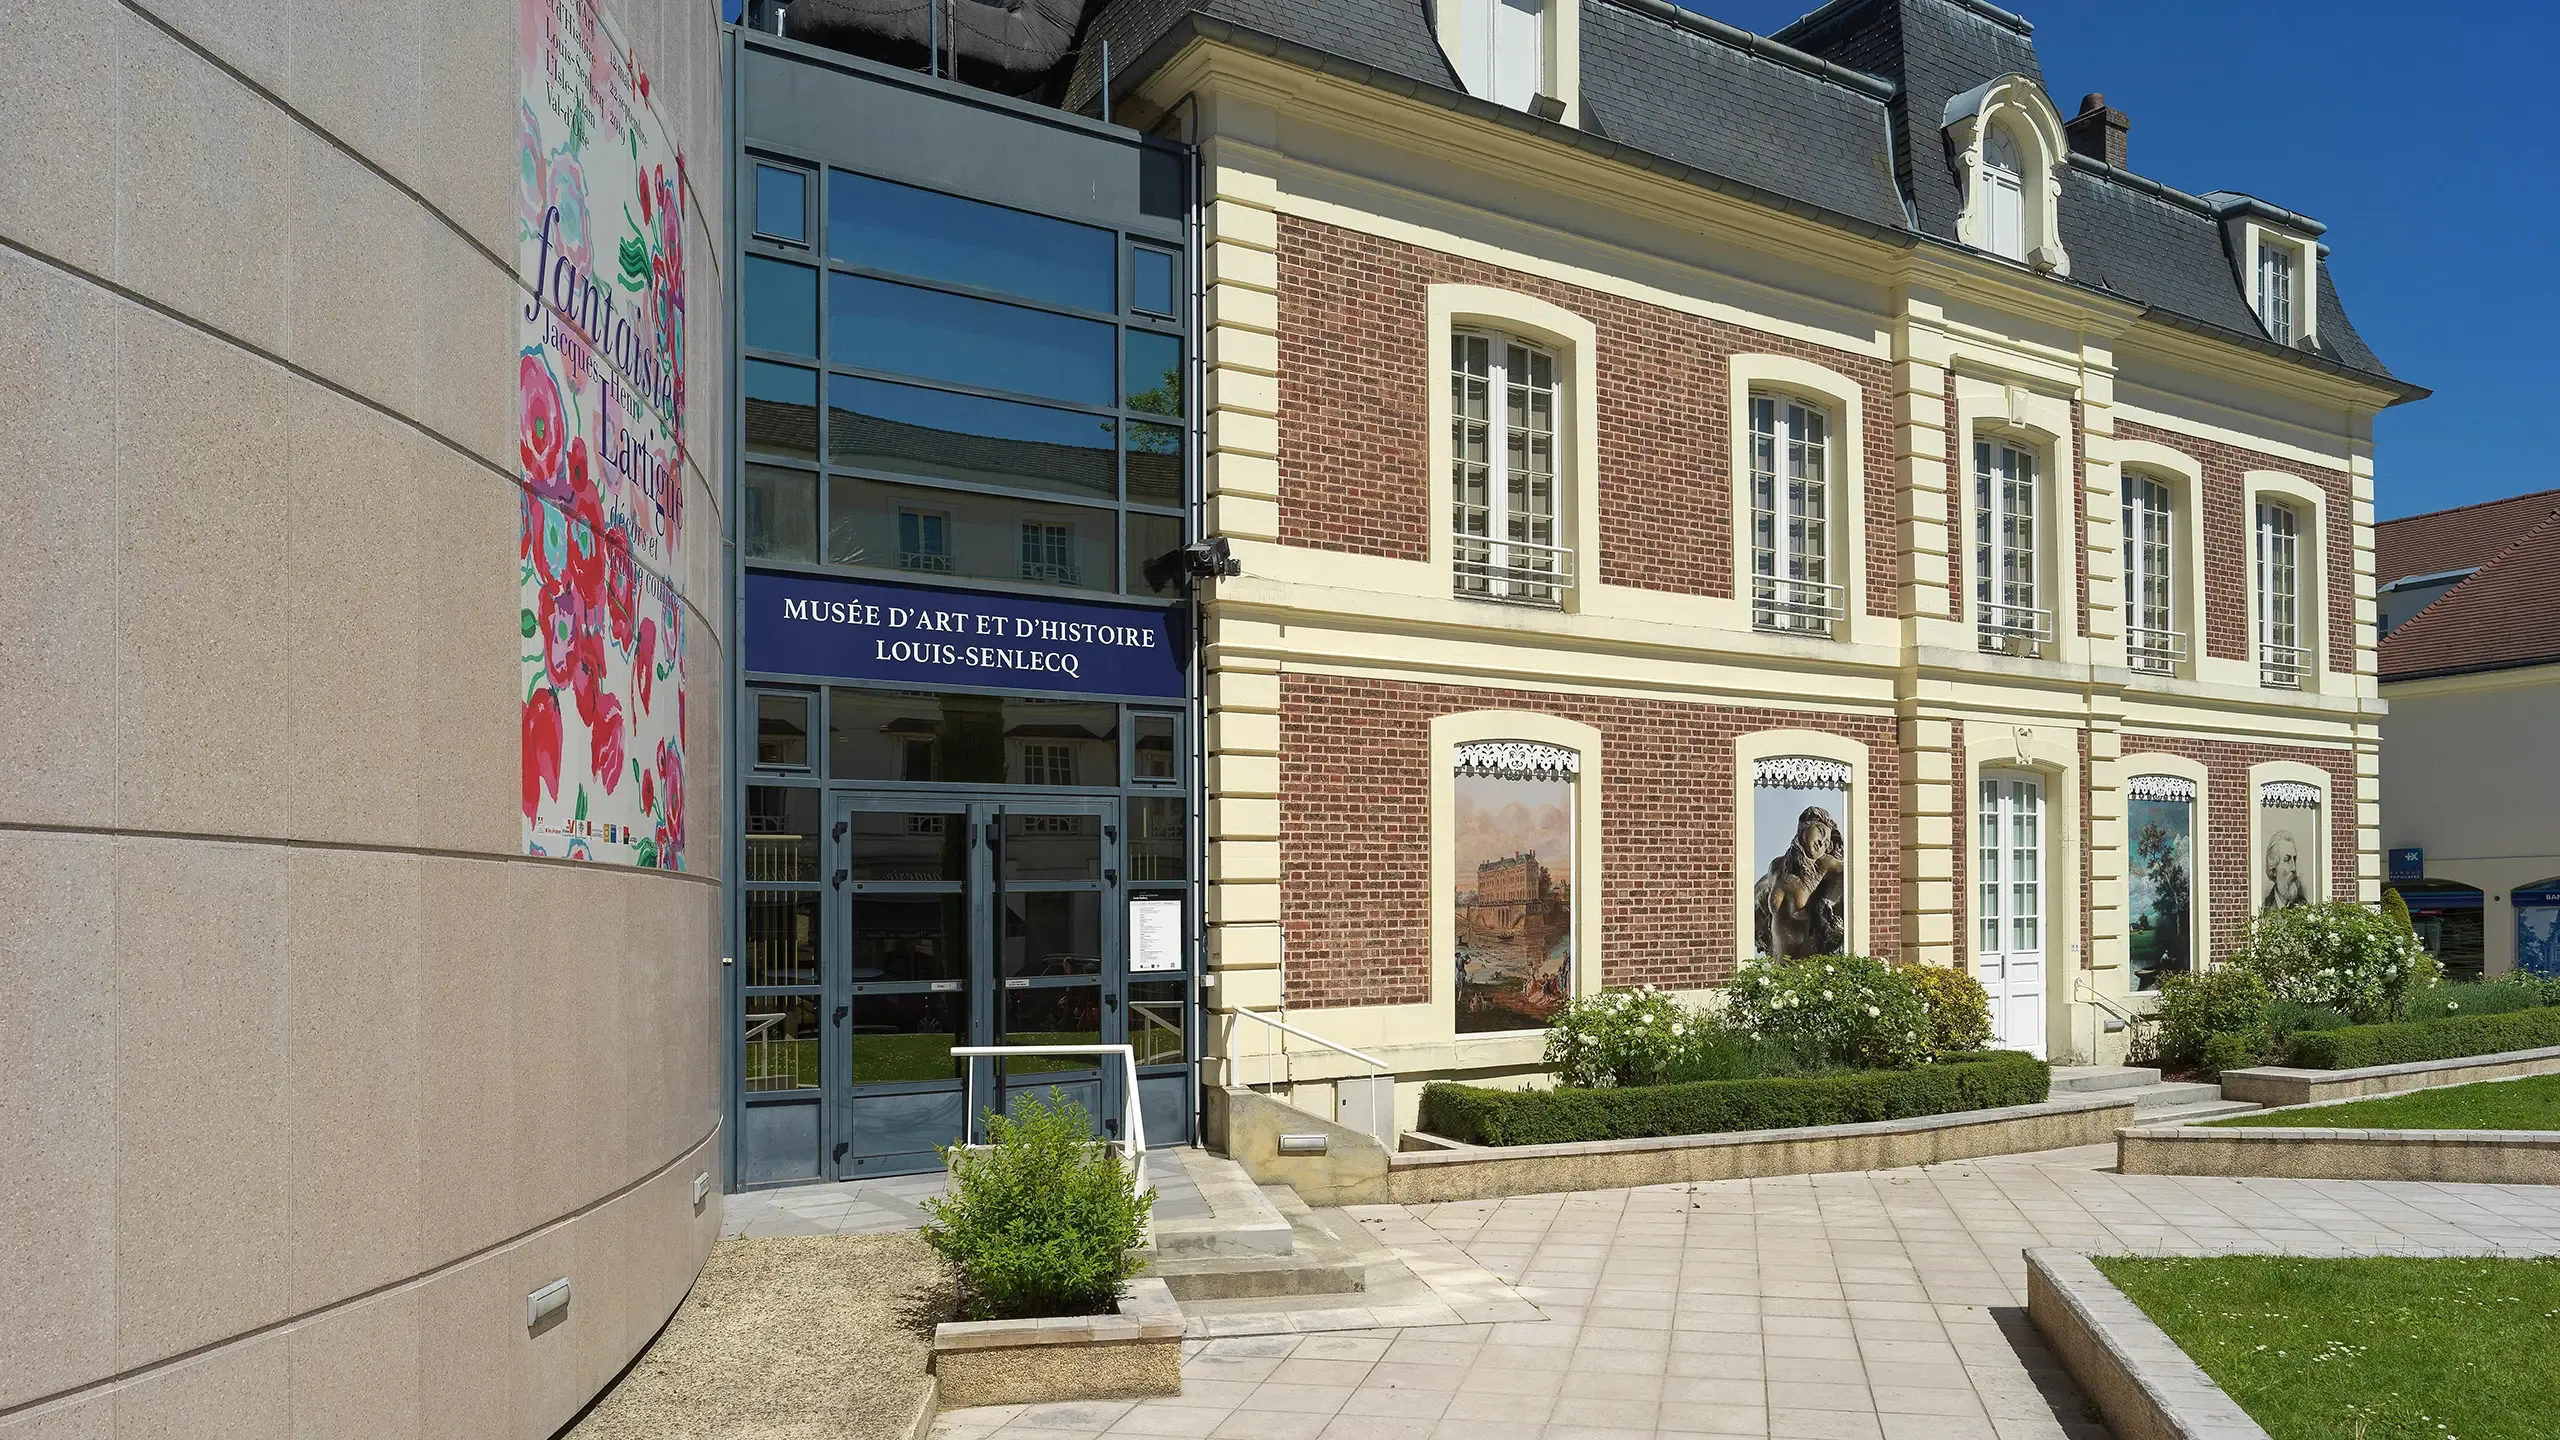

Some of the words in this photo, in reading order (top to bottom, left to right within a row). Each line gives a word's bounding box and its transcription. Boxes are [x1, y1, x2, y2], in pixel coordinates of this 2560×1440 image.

[545, 15, 605, 119] Louis-Senlecq
[609, 110, 626, 146] 2019
[526, 206, 679, 433] fantaisies
[542, 309, 599, 384] Jacques
[610, 365, 641, 424] Henri
[599, 374, 684, 537] Lartigue
[610, 493, 647, 551] décors
[649, 533, 659, 561] et
[609, 545, 644, 588] haute
[783, 598, 881, 626] MUSÉE
[888, 607, 969, 633] D'ART
[976, 614, 1009, 636] ET
[1015, 617, 1155, 649] D'HISTOIRE
[876, 639, 1080, 679] LOUIS-SENLECQ
